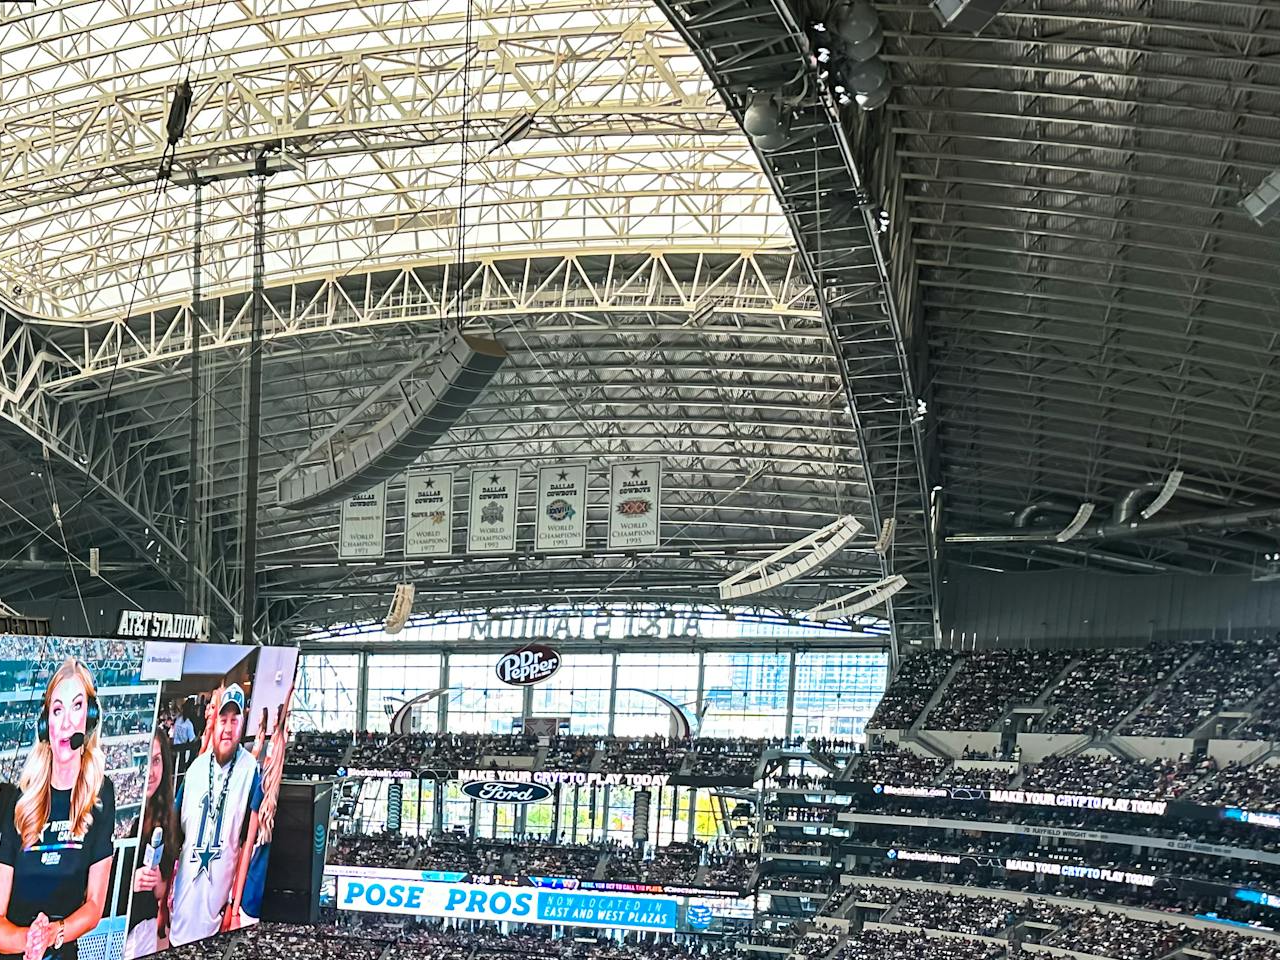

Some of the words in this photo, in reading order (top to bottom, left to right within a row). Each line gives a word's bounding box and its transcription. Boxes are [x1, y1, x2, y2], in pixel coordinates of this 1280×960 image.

[118, 610, 152, 636] AT&T
[152, 612, 204, 639] STADIUM
[498, 654, 558, 682] Pepper
[520, 651, 543, 666] Dr
[348, 768, 412, 778] Blockchain.com
[458, 770, 495, 781] MAKE
[497, 770, 531, 782] YOUR
[534, 772, 585, 785] CRYPTO
[587, 774, 623, 786] PLAY
[626, 774, 670, 786] TODAY
[478, 783, 533, 801] Ford
[884, 785, 947, 797] Blockchain.com
[990, 790, 1025, 804] MAKE
[1025, 792, 1056, 805] YOUR
[1056, 795, 1102, 809] CRYPTO
[1102, 797, 1131, 812] PLAY
[1132, 800, 1167, 815] TODAY
[897, 850, 960, 864] Blockchain.com
[1006, 859, 1035, 872] MAKE
[1035, 862, 1061, 875] YOUR
[1061, 864, 1100, 879] CRYPTO
[1101, 869, 1124, 883] PLAY
[1125, 872, 1155, 886] TODAY
[344, 883, 424, 908] POSE
[445, 889, 532, 915] PROS
[547, 896, 574, 907] NOW
[581, 898, 640, 911] LOCATED
[648, 903, 662, 912] IN
[544, 906, 569, 917] EAST
[572, 908, 593, 919] AND
[598, 909, 624, 921] WEST
[628, 912, 667, 924] PLAZAS
